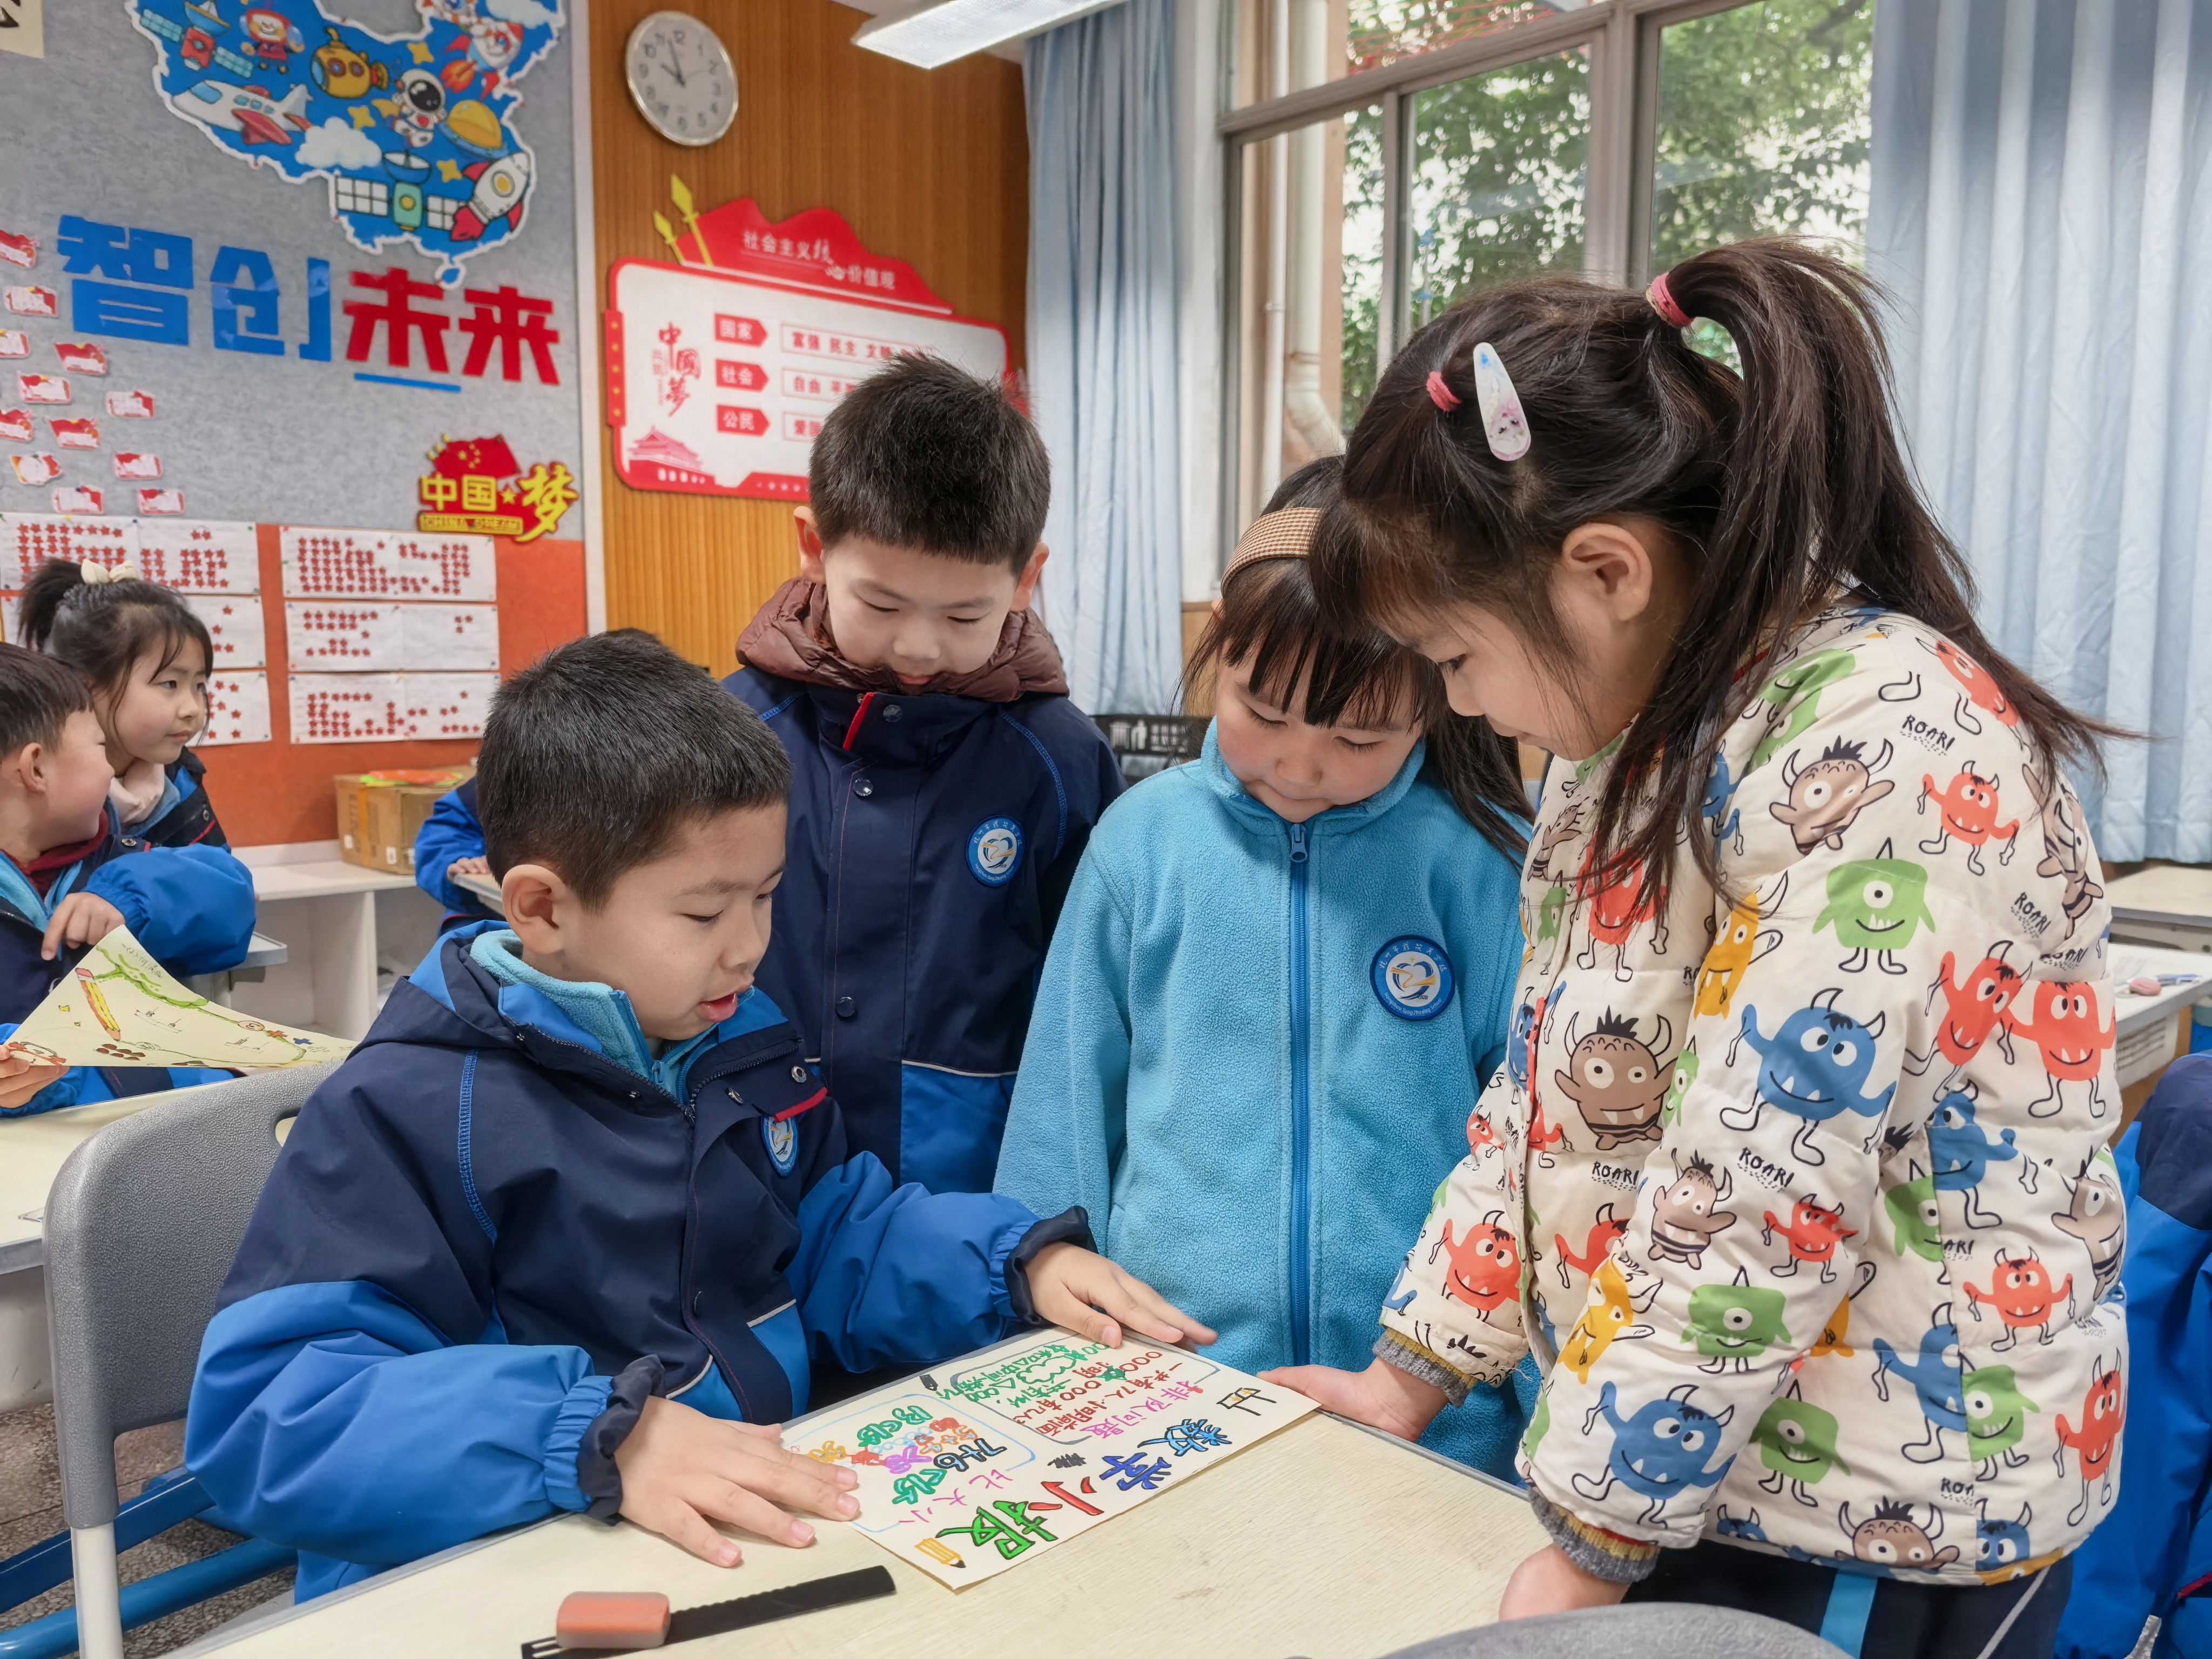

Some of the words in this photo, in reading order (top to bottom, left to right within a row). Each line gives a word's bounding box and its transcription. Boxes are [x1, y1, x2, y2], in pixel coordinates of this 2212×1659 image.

[57, 214, 561, 386] 智创未来
[719, 319, 752, 340] 国家
[721, 364, 753, 386] 社会
[723, 410, 755, 431] 公民
[1080, 1381, 1203, 1439] 排队问题
[899, 1469, 1011, 1522] 比大小
[935, 1419, 1232, 1560] 数学小报
